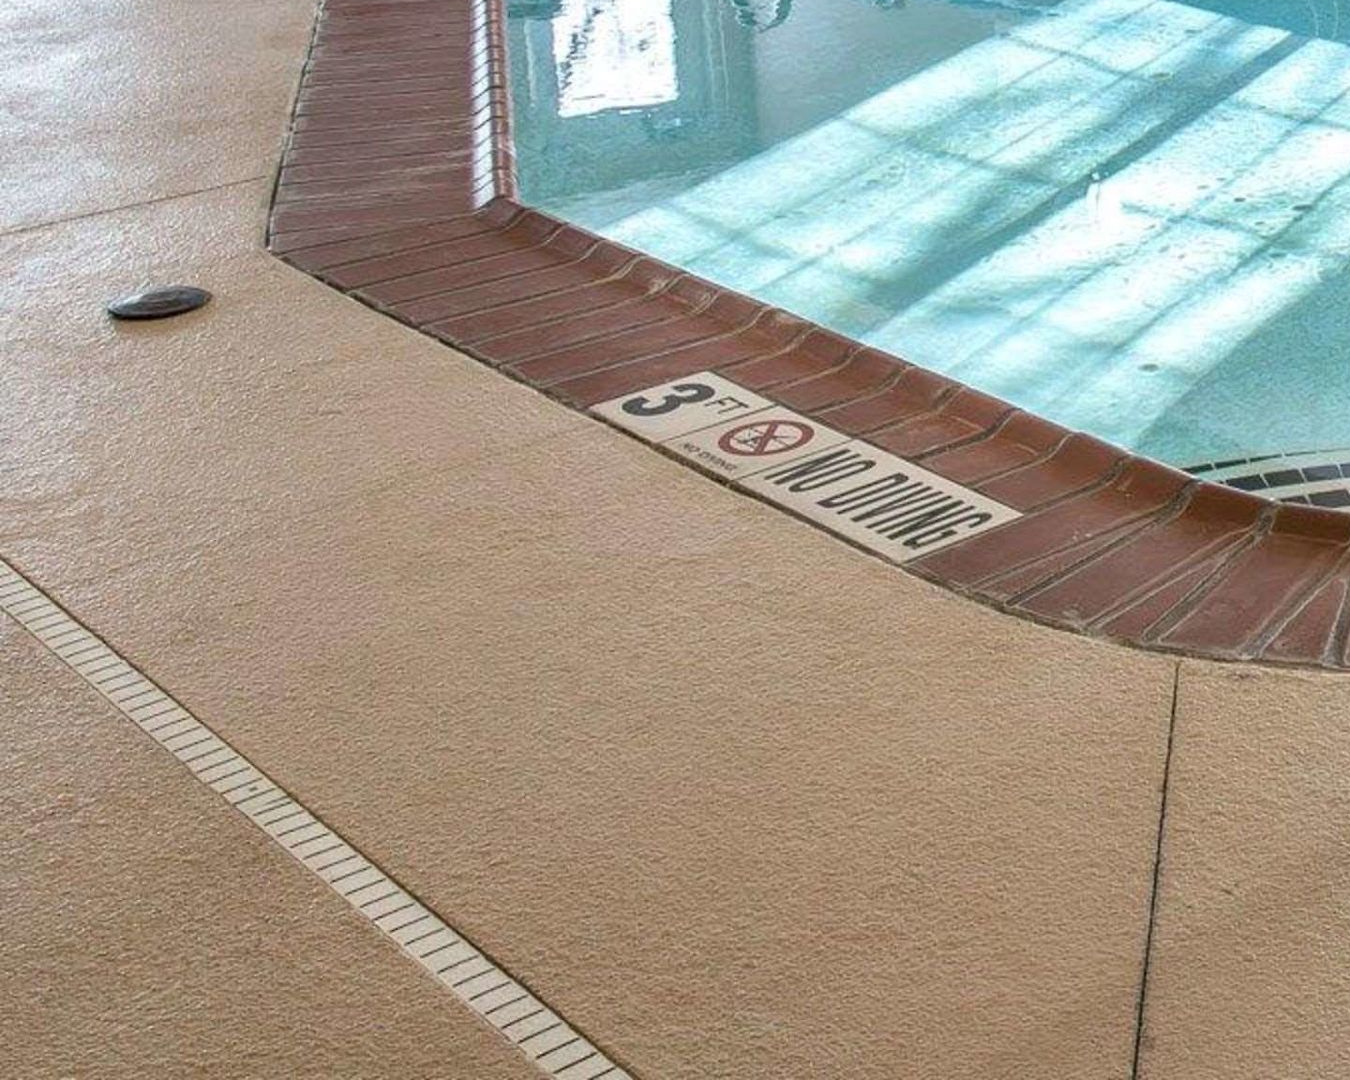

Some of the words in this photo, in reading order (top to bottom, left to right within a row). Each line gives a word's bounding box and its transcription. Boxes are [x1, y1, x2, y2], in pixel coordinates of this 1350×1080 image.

[621, 383, 717, 417] 3
[704, 397, 750, 416] FT
[764, 449, 877, 493] NO
[817, 473, 993, 550] DIVING
